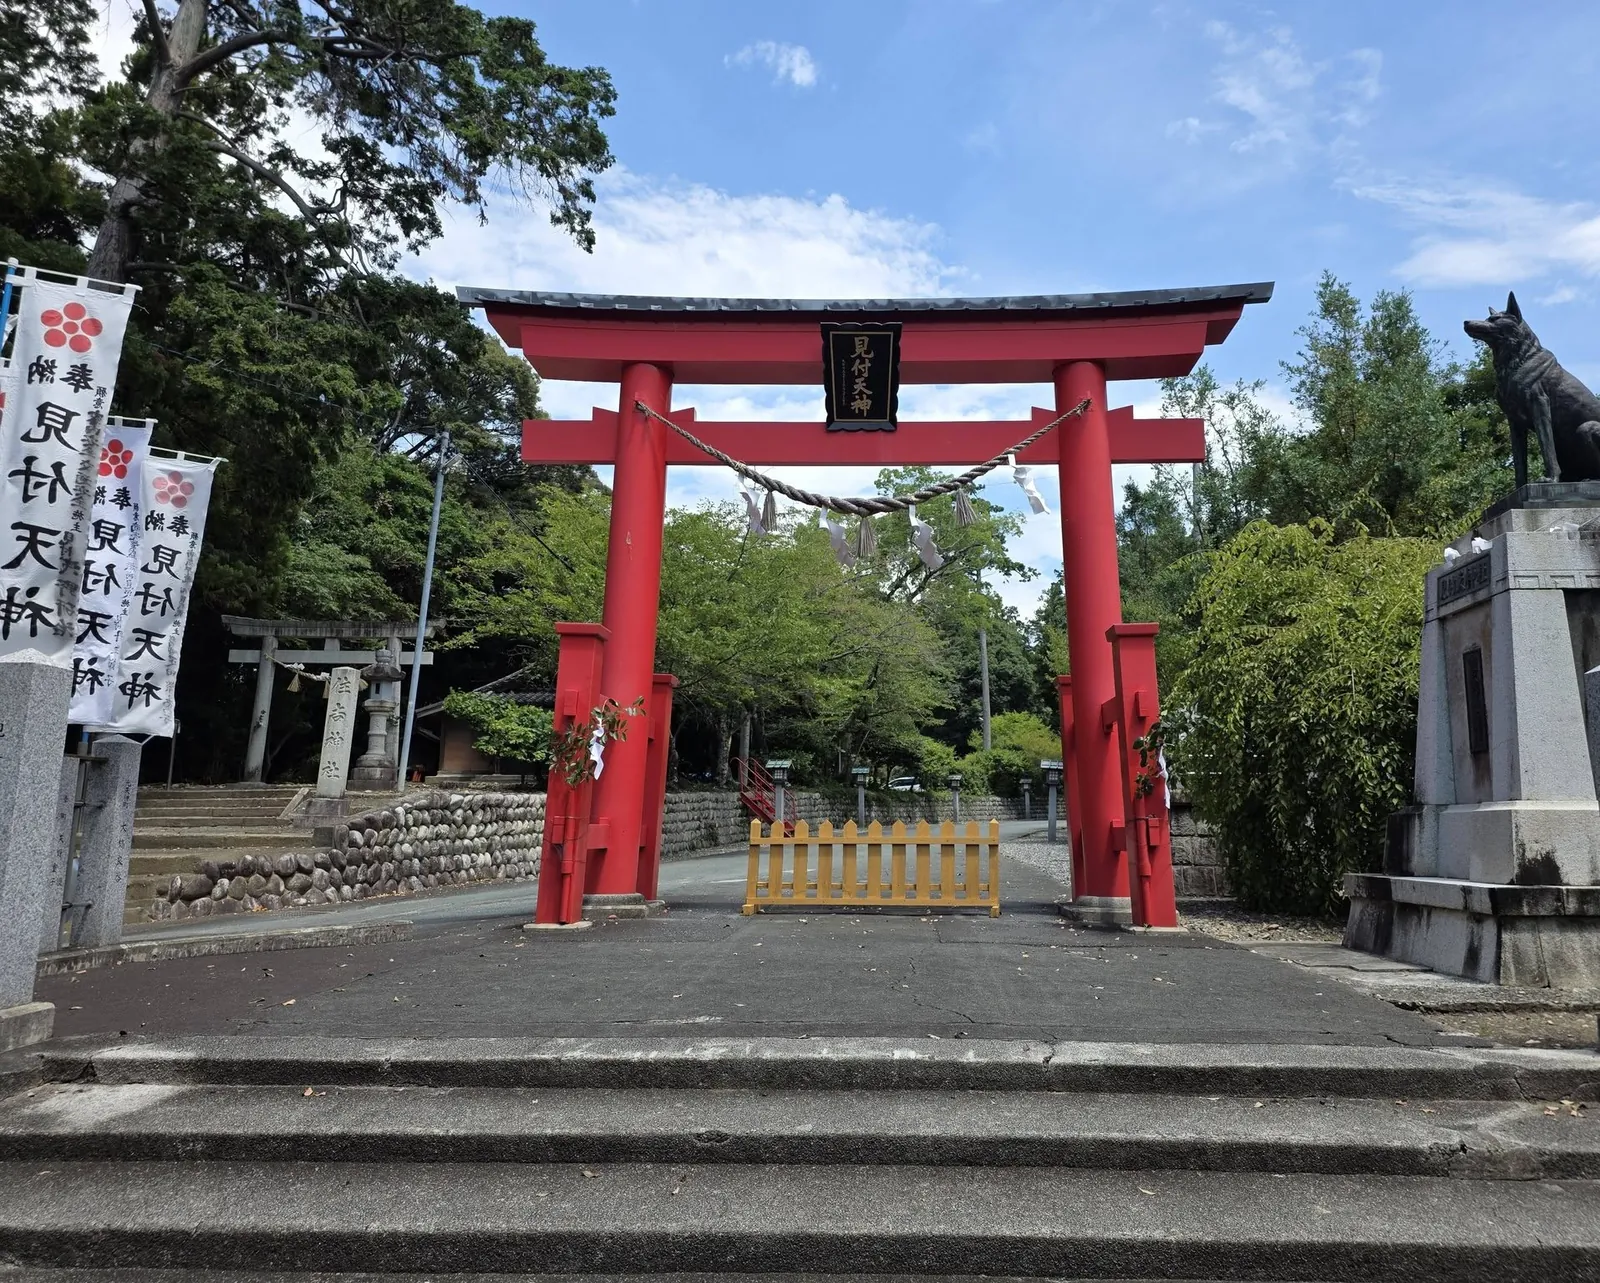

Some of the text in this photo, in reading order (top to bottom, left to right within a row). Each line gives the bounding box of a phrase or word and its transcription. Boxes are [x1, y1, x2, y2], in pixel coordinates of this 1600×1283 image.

[850, 335, 874, 417] 見付天神
[320, 676, 351, 779] 住吉神社
